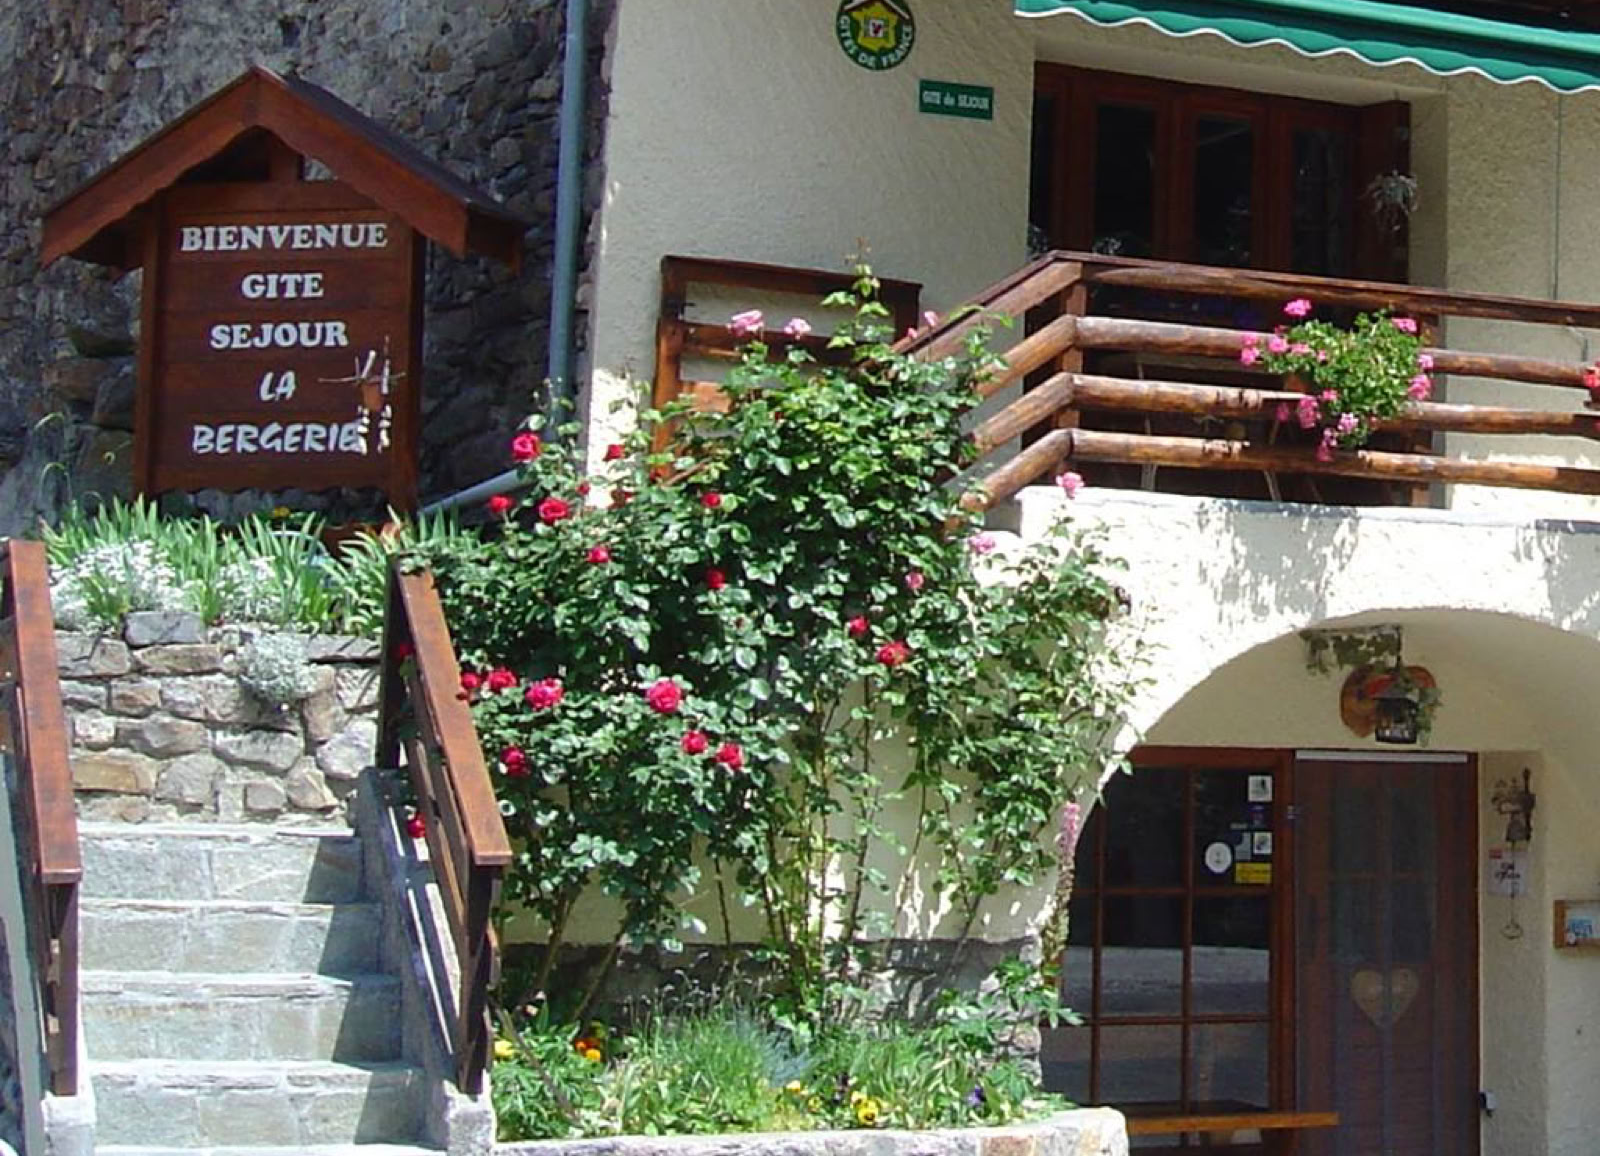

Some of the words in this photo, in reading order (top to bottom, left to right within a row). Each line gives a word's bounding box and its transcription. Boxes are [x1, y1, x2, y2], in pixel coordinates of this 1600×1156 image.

[858, 52, 876, 68] DE
[180, 223, 389, 252] BIENVENUE
[240, 272, 324, 299] GITE
[210, 322, 348, 349] SEJOUR
[259, 372, 297, 401] LA
[192, 422, 361, 454] BERGERIE
